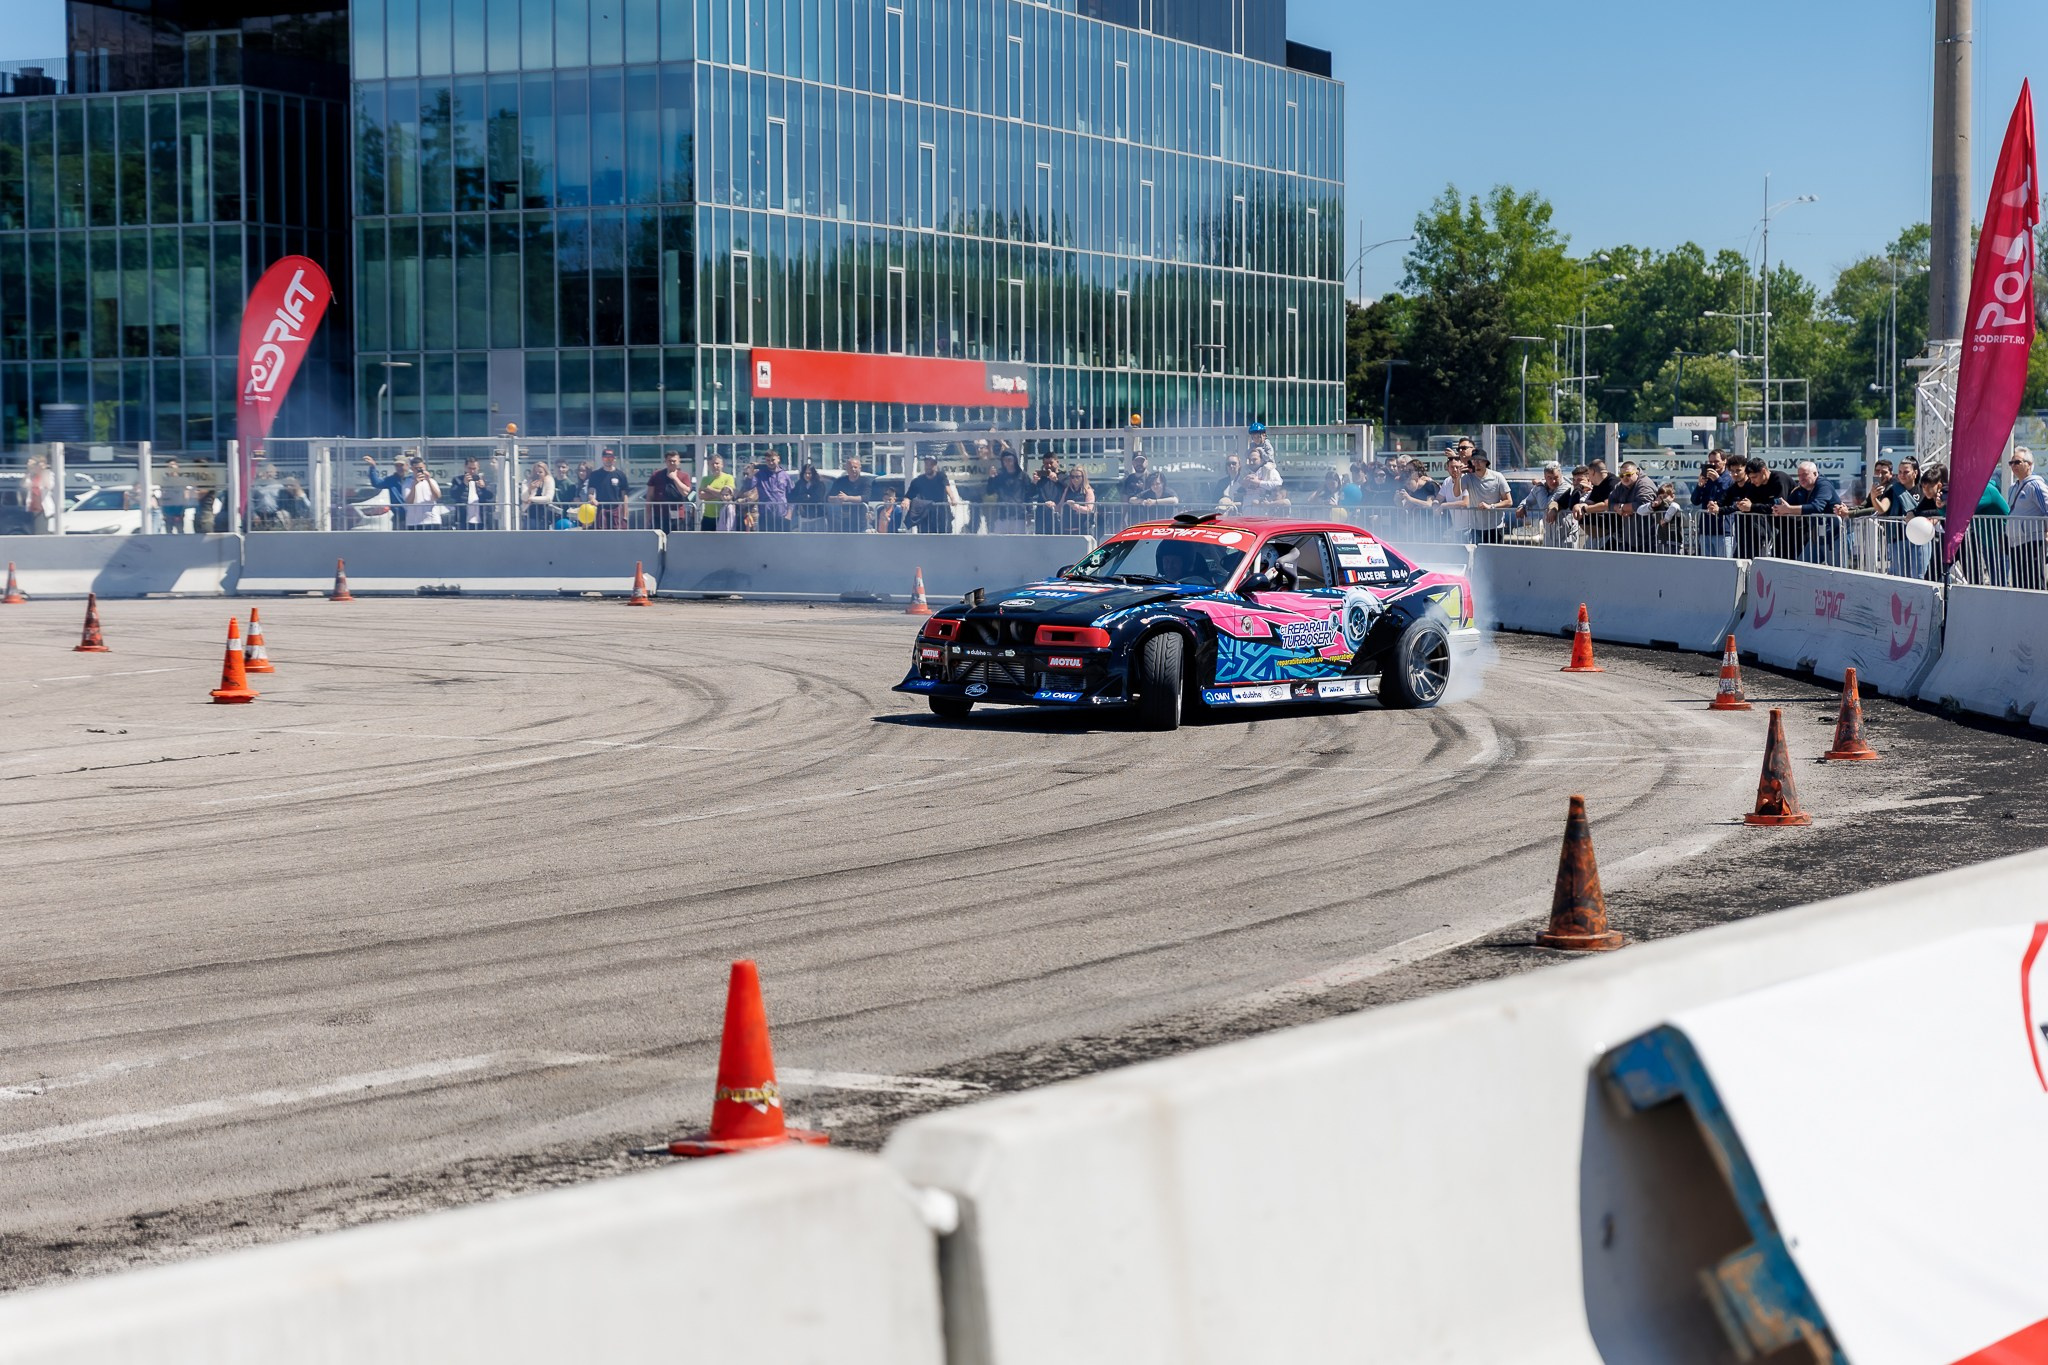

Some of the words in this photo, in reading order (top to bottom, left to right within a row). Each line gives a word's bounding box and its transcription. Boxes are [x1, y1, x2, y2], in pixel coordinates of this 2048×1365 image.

[1973, 334, 2026, 346] RODRIFT.RO
[1357, 571, 1375, 581] ALICE
[1281, 630, 1337, 649] TURBOSERV
[1049, 657, 1082, 667] MOTUL
[1213, 692, 1230, 700] OMV
